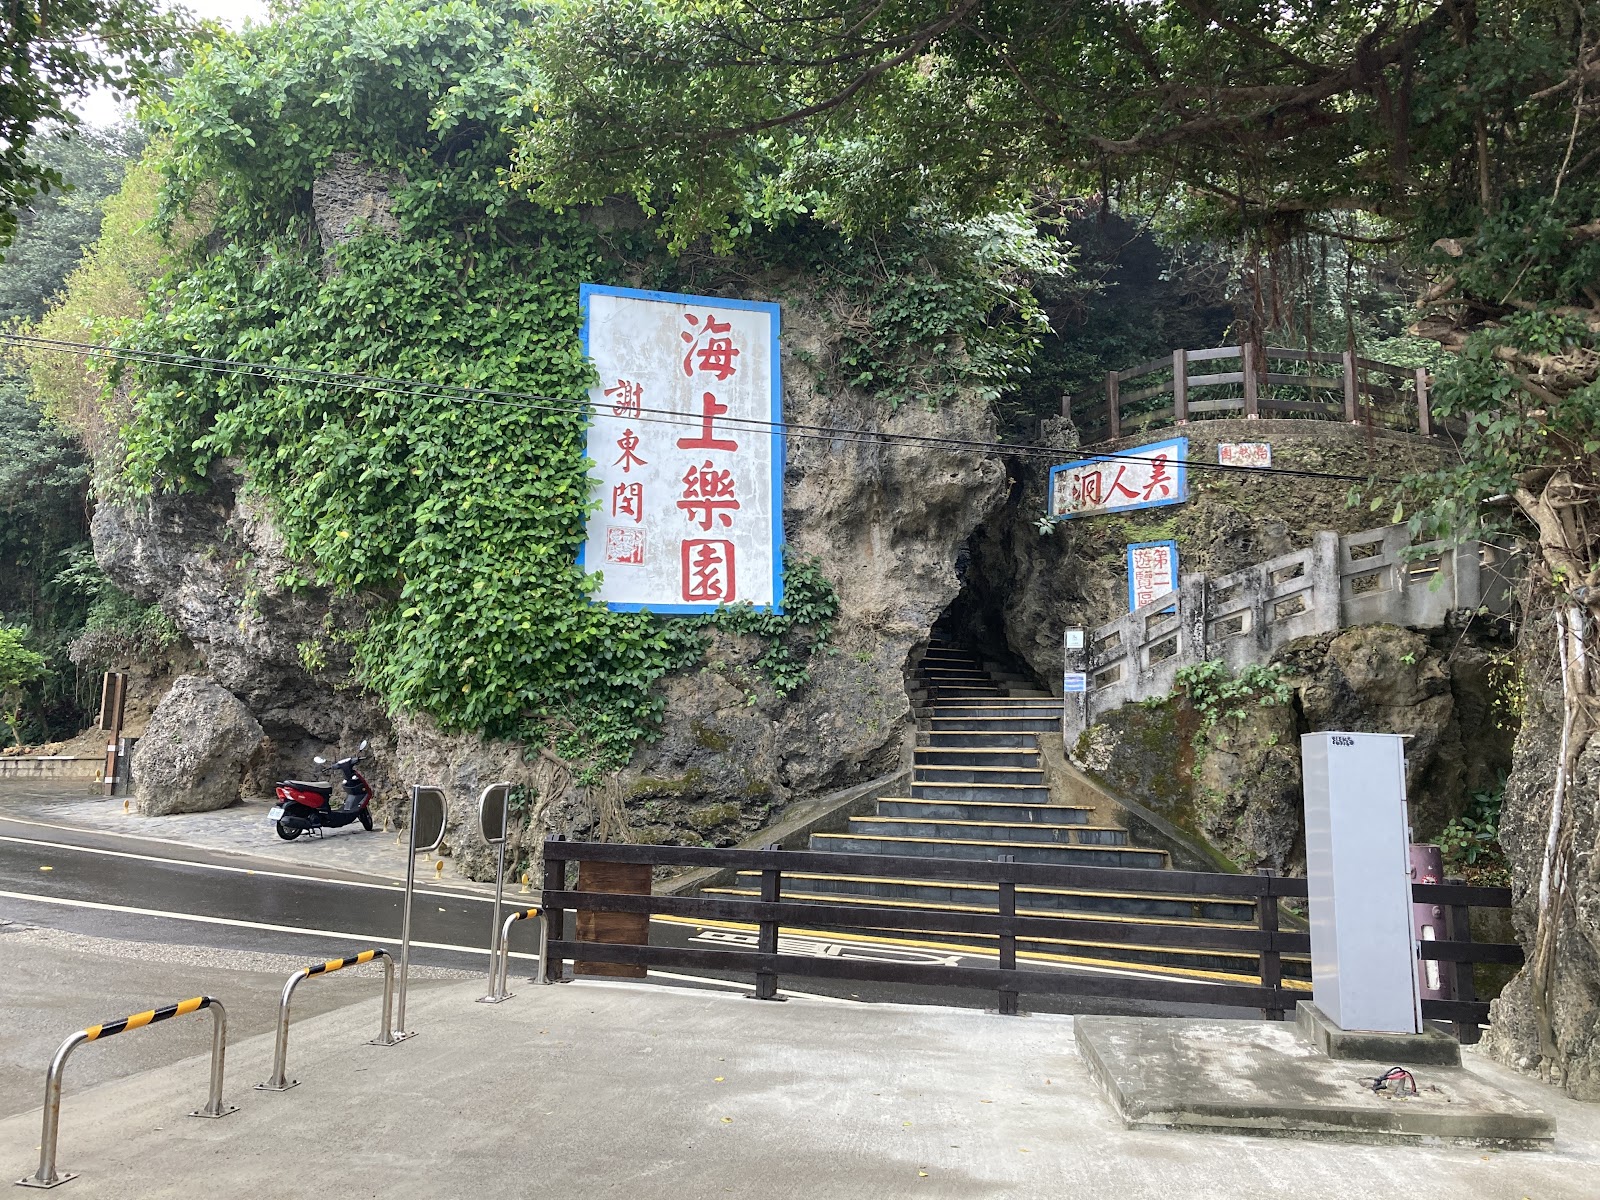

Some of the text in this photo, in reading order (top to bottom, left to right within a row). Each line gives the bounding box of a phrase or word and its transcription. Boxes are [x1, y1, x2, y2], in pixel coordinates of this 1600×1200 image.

[604, 379, 648, 524] 謝東閔
[676, 313, 740, 603] 海上樂園
[1134, 550, 1154, 608] 遊覽區
[1153, 549, 1170, 586] 第二
